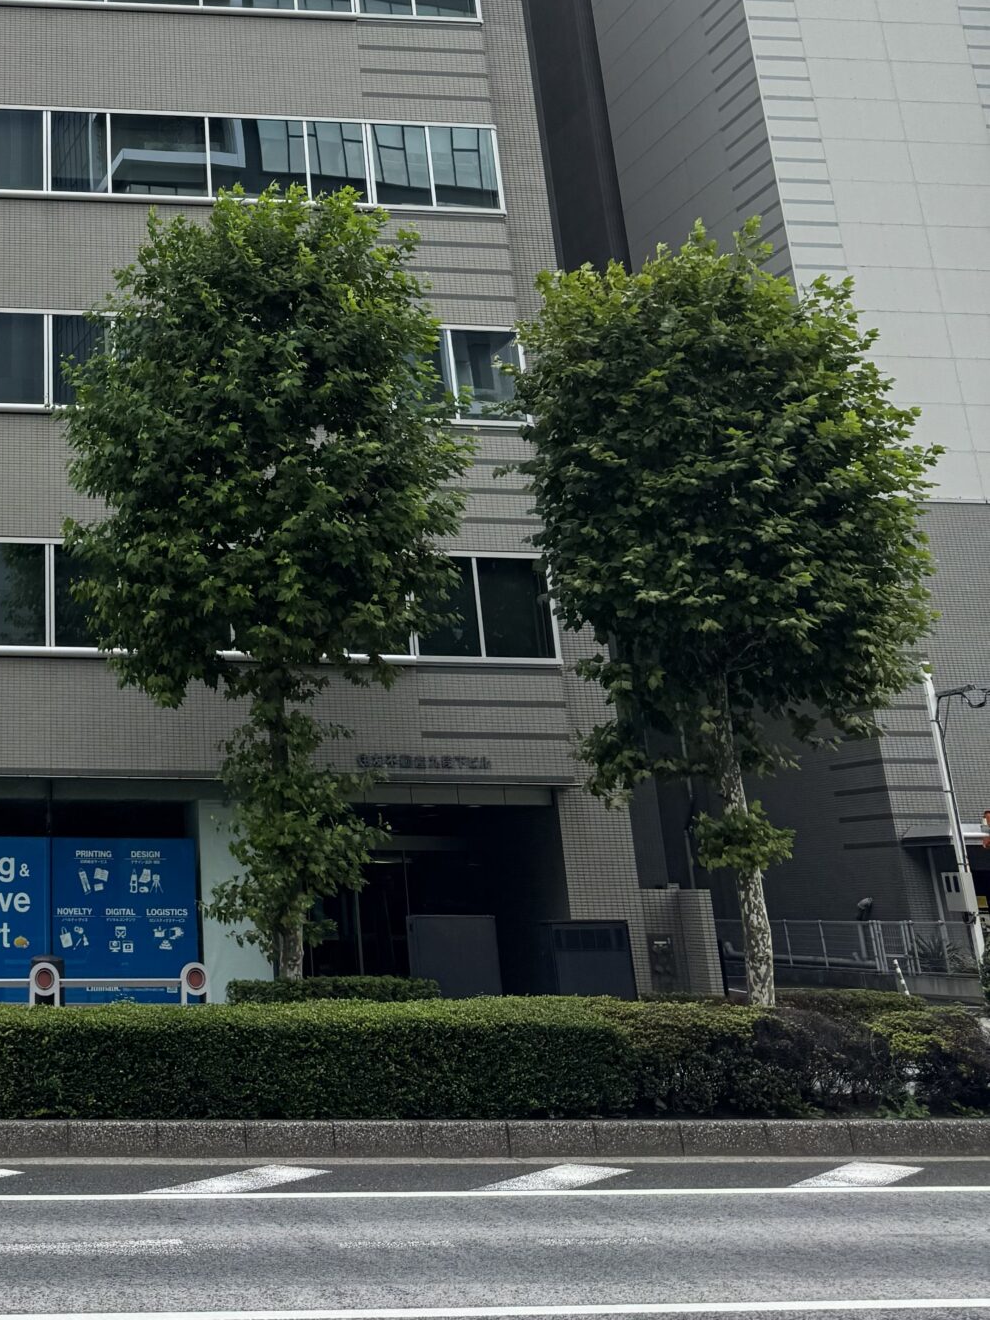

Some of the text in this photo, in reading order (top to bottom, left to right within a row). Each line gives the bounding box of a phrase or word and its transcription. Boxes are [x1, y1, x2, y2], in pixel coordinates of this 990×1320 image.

[75, 850, 112, 858] PRINTING
[19, 863, 30, 877] &
[146, 908, 188, 916] LOGISTICS
